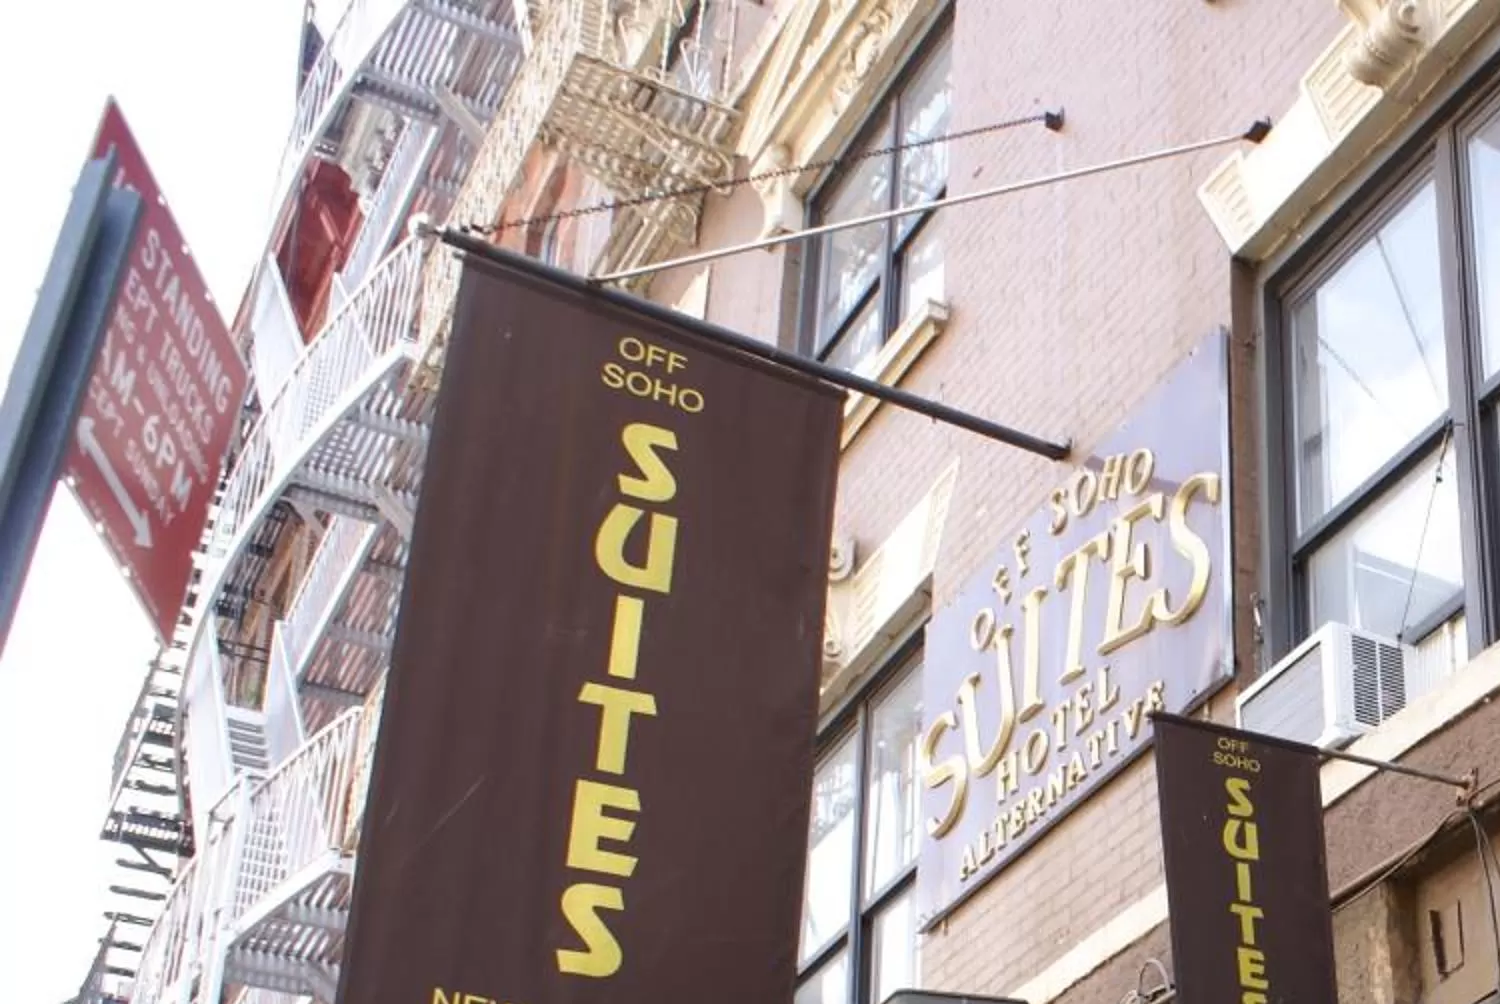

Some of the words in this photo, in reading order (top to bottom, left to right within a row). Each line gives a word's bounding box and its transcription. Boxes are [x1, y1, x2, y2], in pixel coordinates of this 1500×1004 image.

[141, 227, 232, 414] STANDING
[160, 328, 214, 444] TRUCKS
[601, 362, 705, 413] SOHO
[617, 336, 689, 375] OFF
[970, 528, 1033, 653] OFF
[1049, 447, 1154, 535] SOHO
[556, 422, 679, 978] SUITES
[921, 472, 1221, 839] SUITES
[959, 678, 1167, 882] ALTERNATIVE
[996, 664, 1122, 806] HOTEL
[1213, 751, 1261, 773] SOHO
[1217, 737, 1249, 753] OFF
